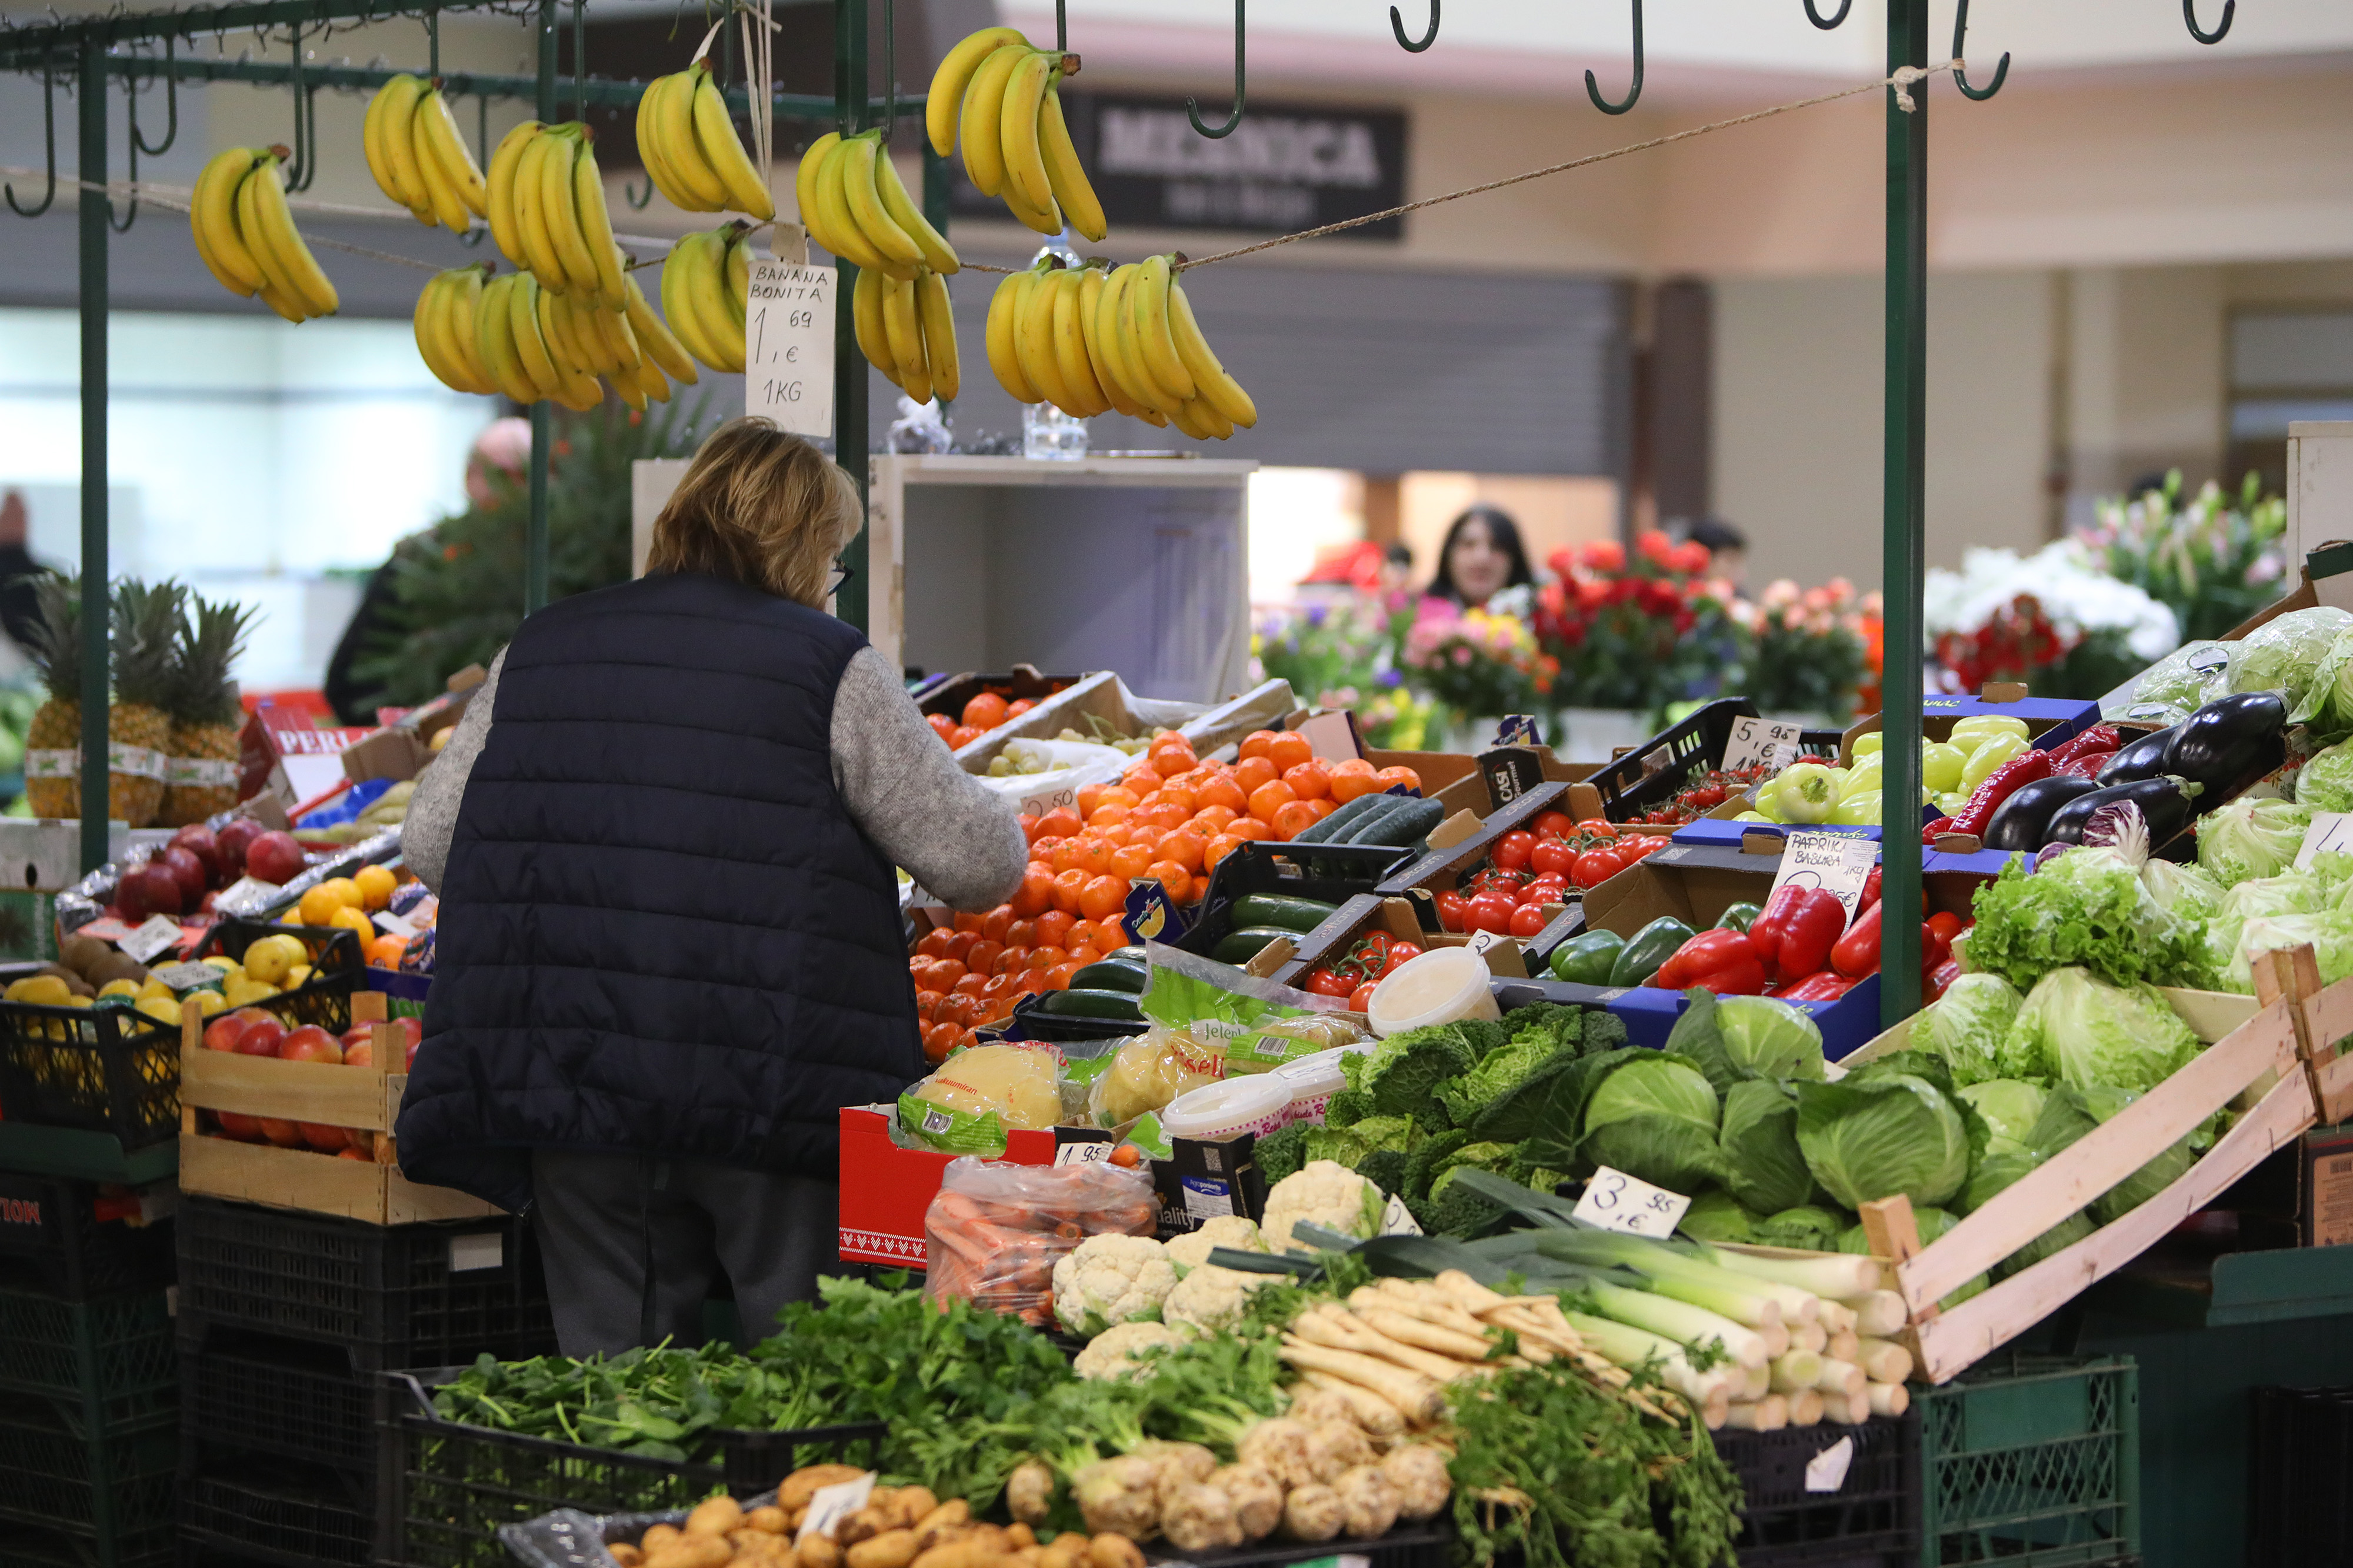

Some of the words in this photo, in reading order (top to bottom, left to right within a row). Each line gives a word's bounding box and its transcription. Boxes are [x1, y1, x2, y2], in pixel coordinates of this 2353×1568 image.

[756, 266, 828, 285] BANANA
[750, 283, 822, 302] BONITA
[790, 309, 812, 327] 69
[764, 379, 802, 404] 1KG
[1737, 721, 1758, 741] 5
[1769, 726, 1796, 740] 95
[276, 730, 371, 754] PERL
[1495, 770, 1514, 802] CASI
[1507, 760, 1522, 799] Gourmet
[1052, 789, 1073, 808] 50
[1081, 1146, 1102, 1162] 95
[1595, 1175, 1627, 1210] 3
[1156, 1207, 1195, 1230] uality
